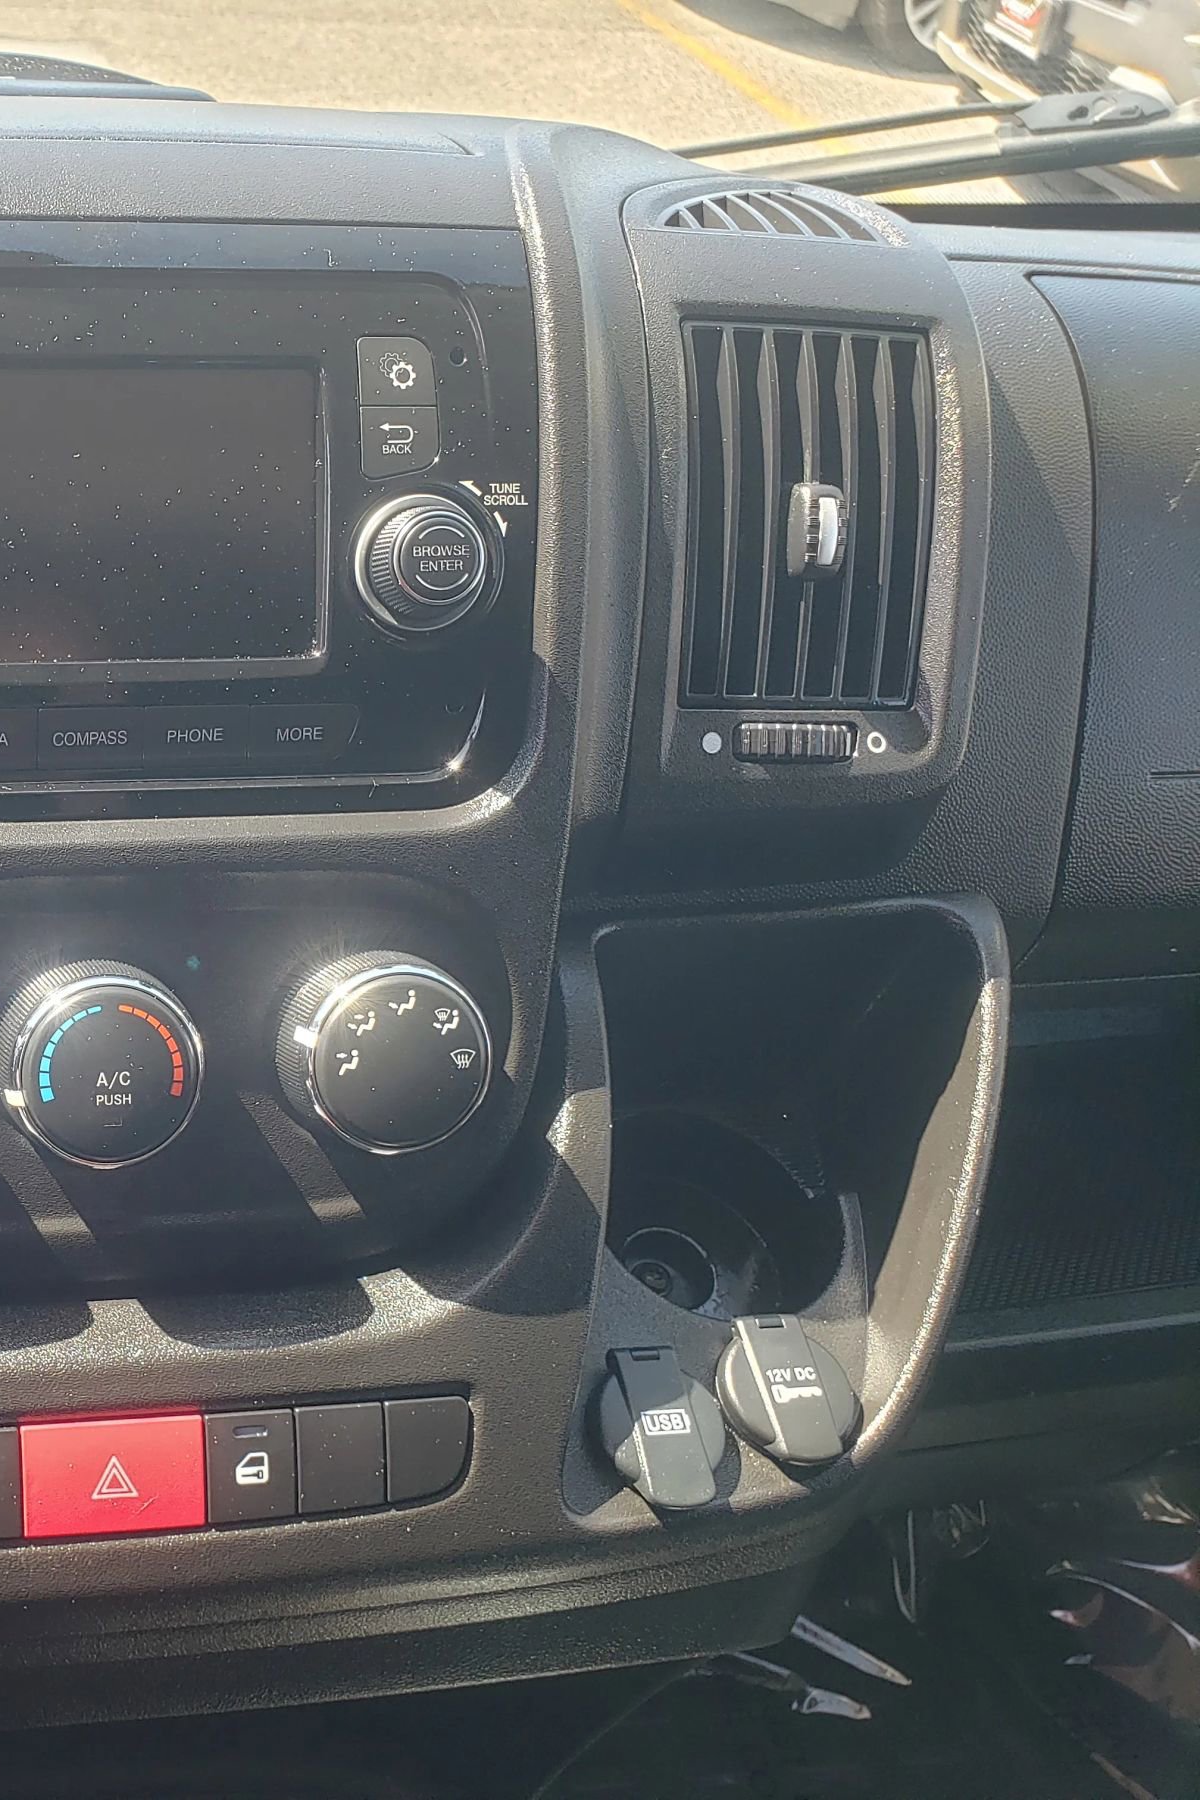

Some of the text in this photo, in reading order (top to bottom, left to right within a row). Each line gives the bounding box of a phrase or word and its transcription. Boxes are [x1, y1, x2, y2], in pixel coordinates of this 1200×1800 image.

[382, 444, 412, 455] BACK
[489, 483, 520, 495] TUNE
[483, 494, 528, 506] SCROLL
[412, 545, 470, 557] BROWSE
[419, 560, 464, 572] ENTER
[52, 731, 128, 747] COMPASS
[166, 728, 224, 743] PHONE
[275, 726, 324, 741] MORE
[96, 1070, 131, 1088] A/C
[95, 1093, 132, 1106] PUSH
[765, 1367, 816, 1383] 12V DC
[647, 1412, 682, 1432] USB
